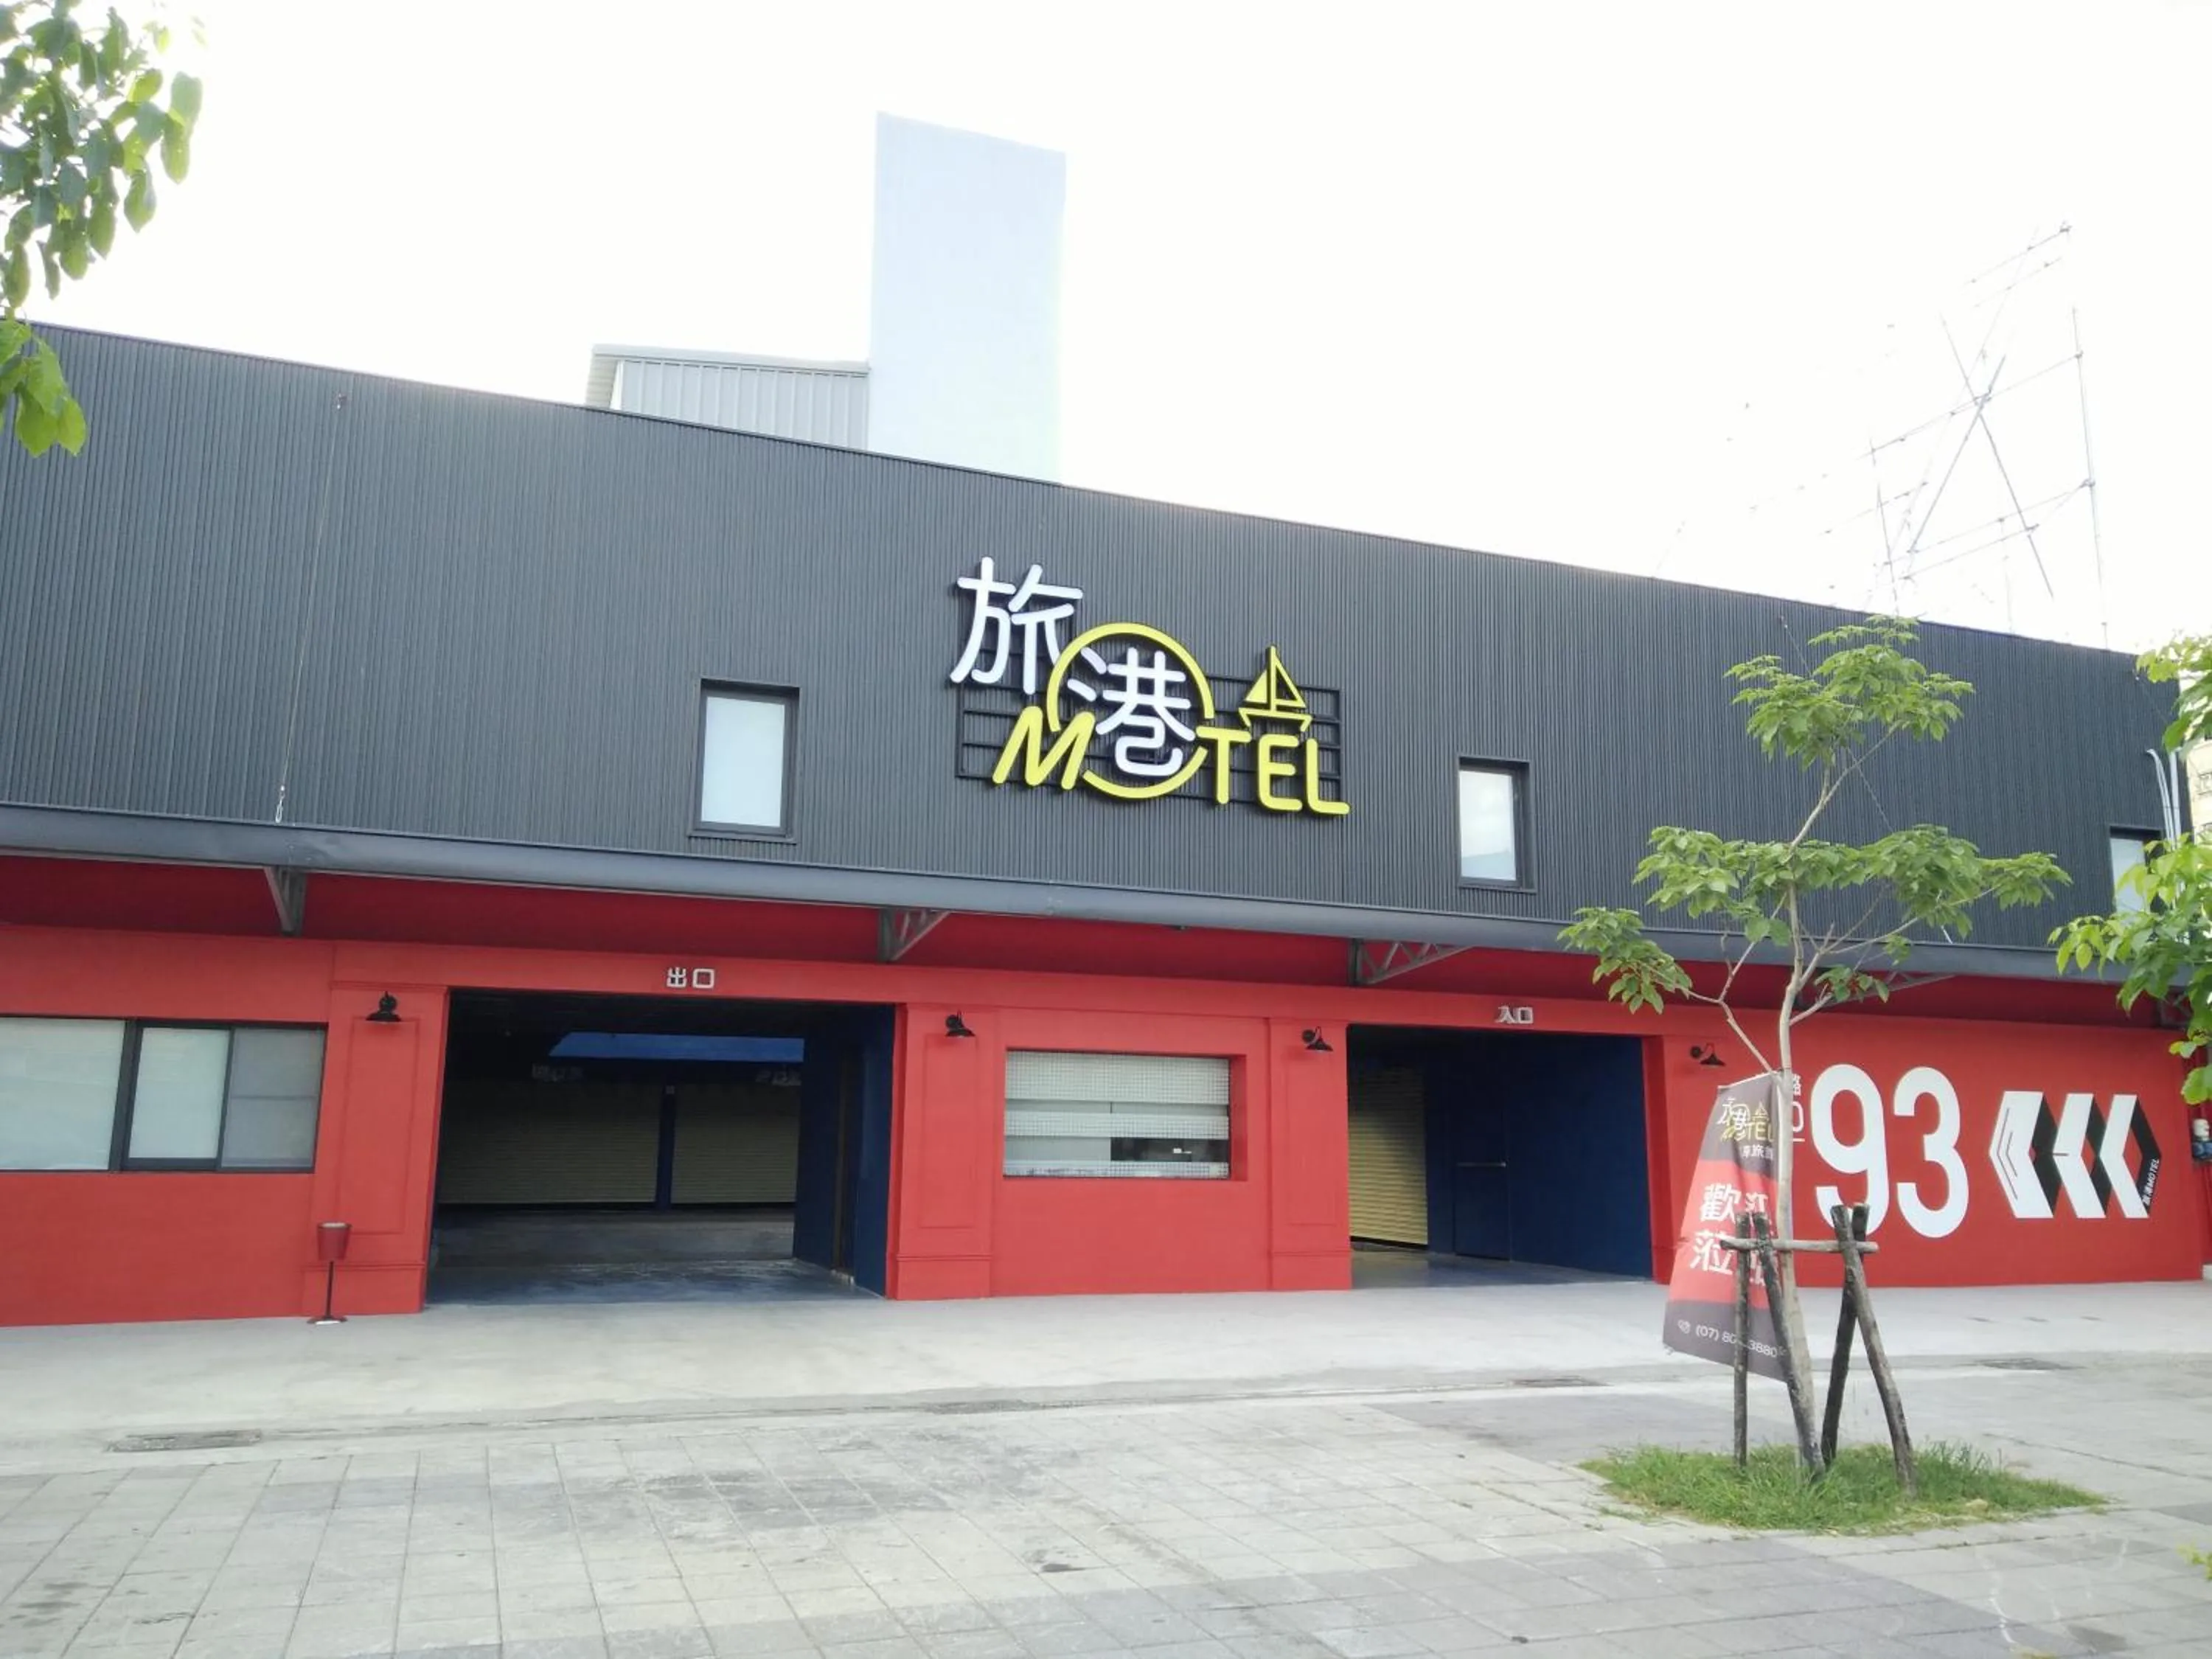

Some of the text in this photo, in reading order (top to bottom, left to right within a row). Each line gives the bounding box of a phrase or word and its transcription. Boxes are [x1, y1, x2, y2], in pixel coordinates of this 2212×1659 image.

[950, 556, 1195, 776] 旅港
[992, 693, 1351, 814] MOTEL
[667, 967, 714, 989] 出口
[1495, 1005, 1534, 1024] 入口
[1811, 1064, 1969, 1238] 93
